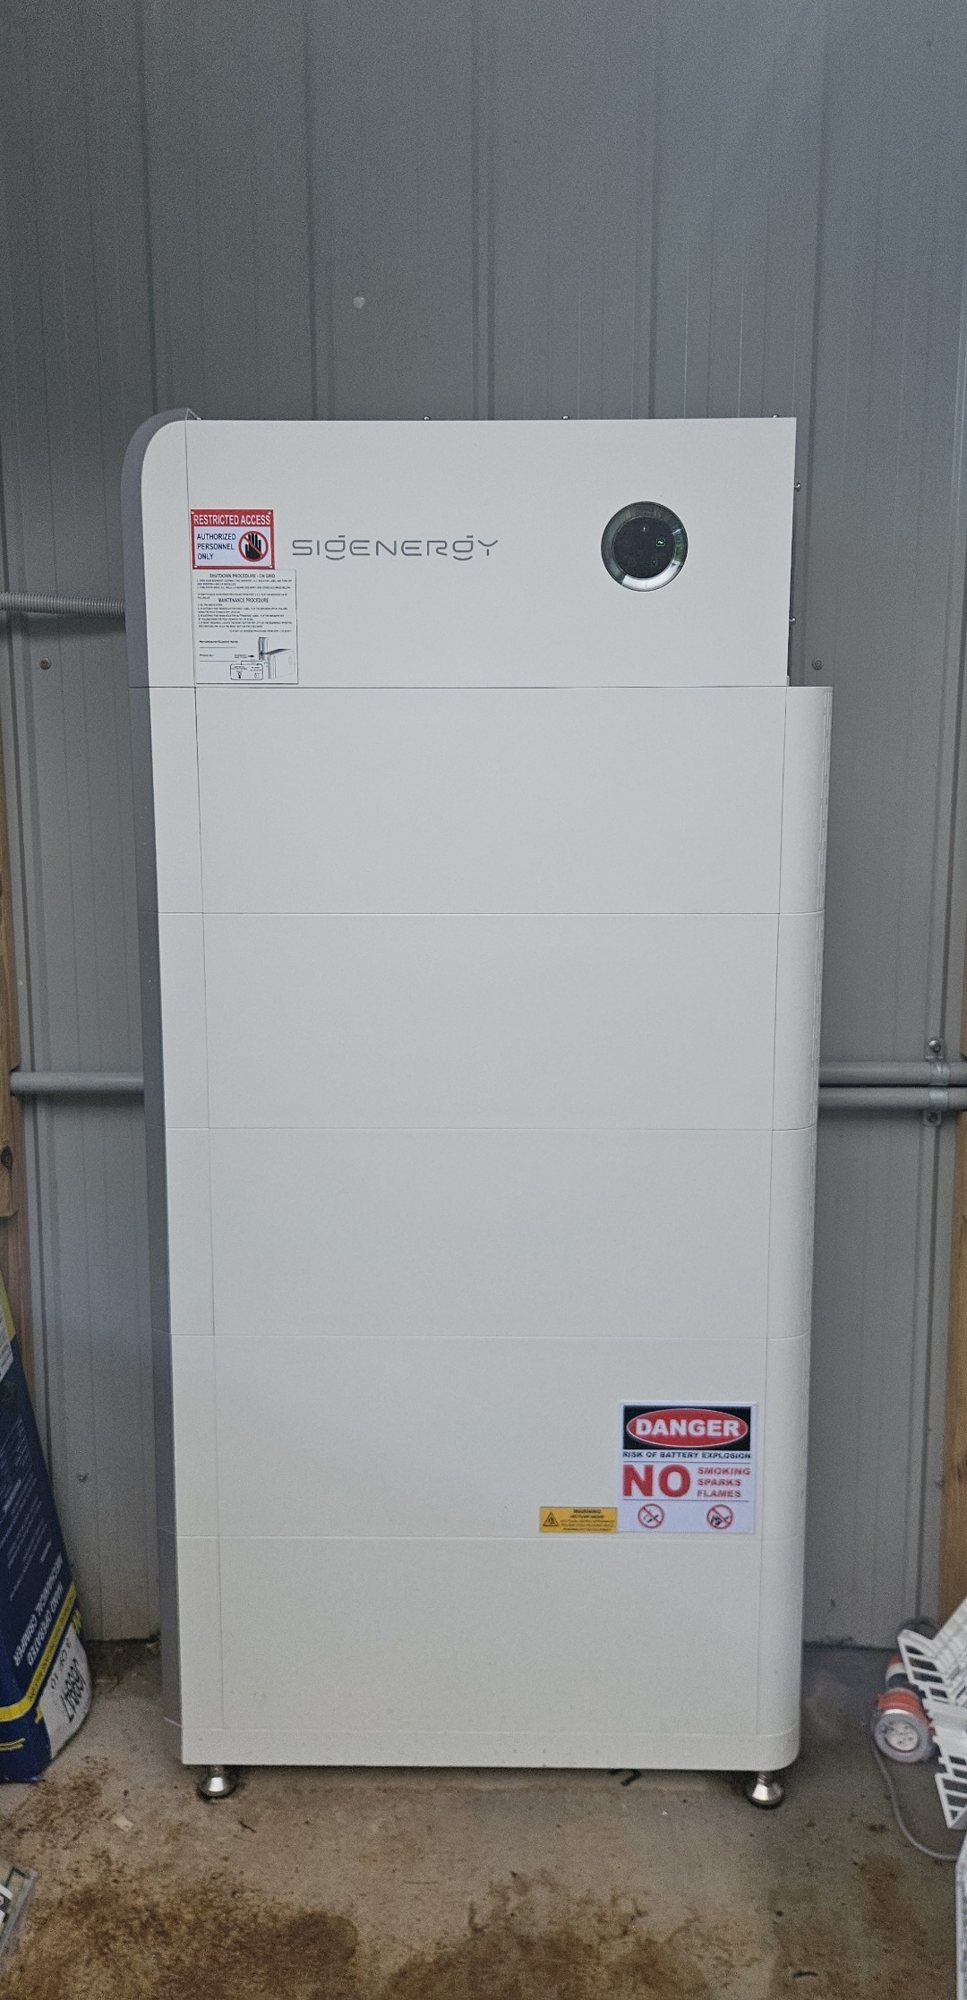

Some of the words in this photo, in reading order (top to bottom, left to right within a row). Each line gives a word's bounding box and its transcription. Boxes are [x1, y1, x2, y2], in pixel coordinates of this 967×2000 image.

[193, 514, 239, 525] RESTRICTED
[241, 514, 271, 525] ACCESS
[197, 533, 237, 541] AUTHORIZED
[197, 543, 234, 551] PERSONNEL
[198, 552, 213, 561] ONLY
[635, 1418, 741, 1437] DANGER
[702, 1451, 751, 1459] EXPLOSION
[697, 1467, 750, 1475] SMOKING
[623, 1464, 691, 1497] NO
[697, 1479, 741, 1487] SPARKS
[697, 1490, 741, 1498] FLAMES
[13, 1613, 38, 1667] CRIMPER
[27, 1611, 53, 1667] OPERATED
